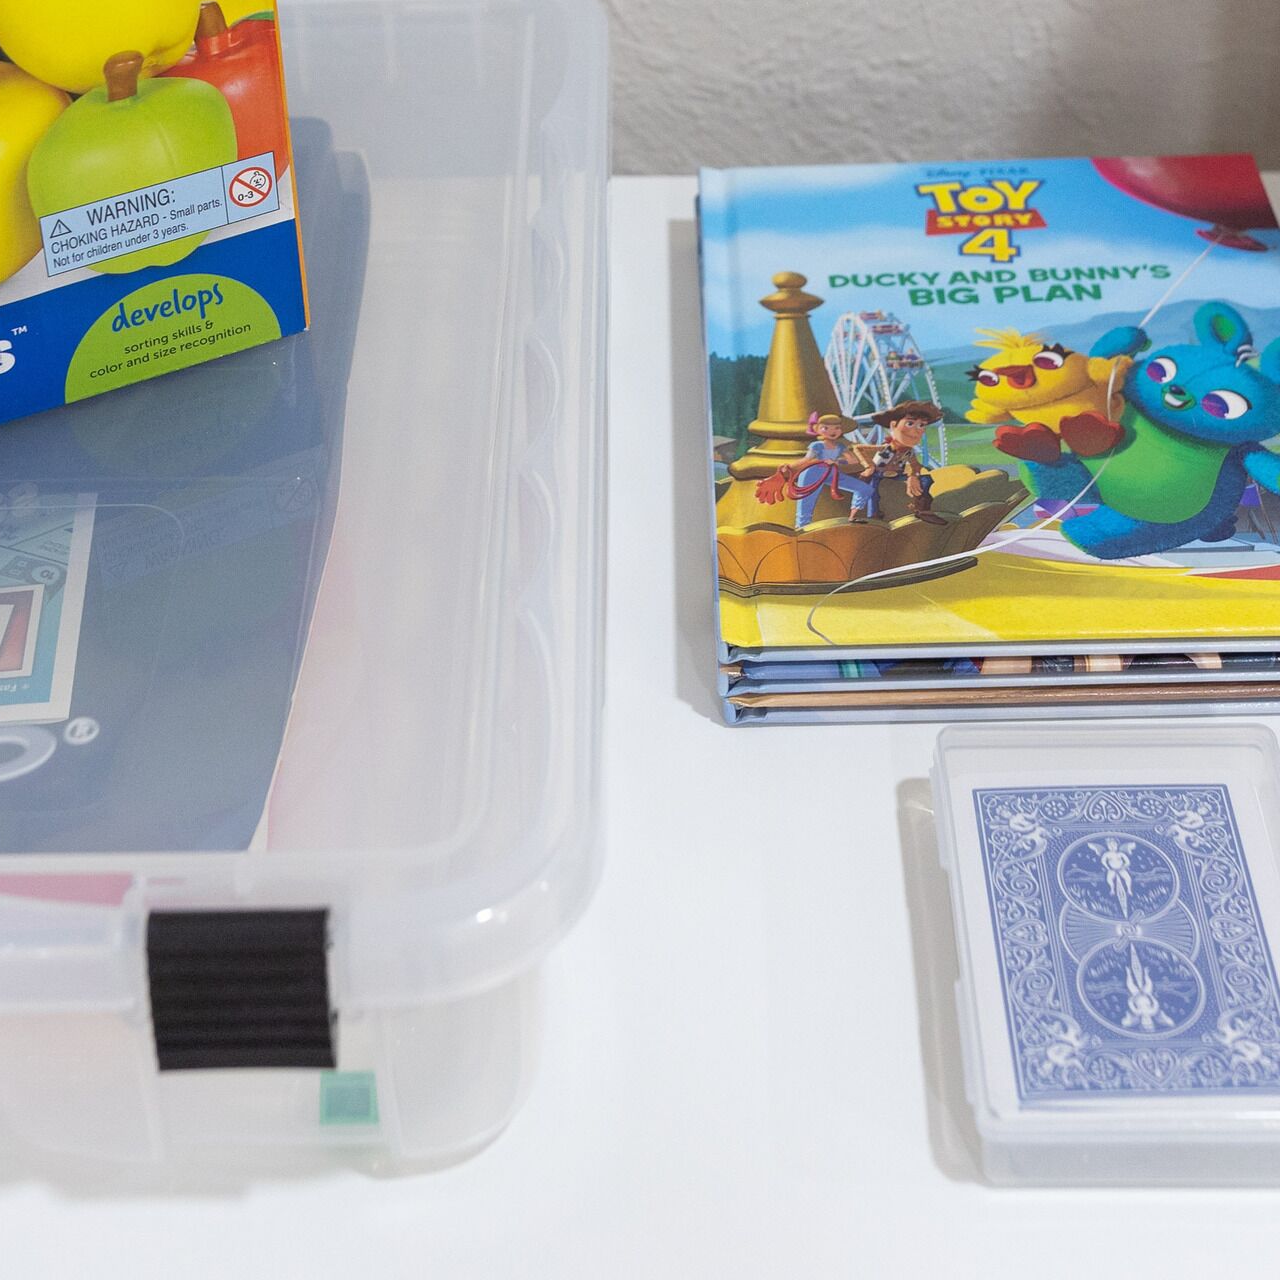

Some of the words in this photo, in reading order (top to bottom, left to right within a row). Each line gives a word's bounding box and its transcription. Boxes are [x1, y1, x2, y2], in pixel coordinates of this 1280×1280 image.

[86, 188, 176, 226] WARNING:
[917, 179, 1043, 213] TOY
[50, 228, 108, 253] CHOKING
[110, 213, 160, 238] HAZARD
[169, 204, 196, 221] Small
[197, 198, 223, 215] parts.
[936, 213, 1032, 228] STORY
[53, 256, 71, 268] Not
[71, 252, 85, 263] for
[86, 240, 124, 259] children
[124, 232, 152, 248] under
[152, 229, 160, 239] 3
[160, 222, 189, 238] years.
[960, 227, 1019, 263] 4
[828, 271, 941, 288] DUCKY
[948, 269, 1016, 285] AND
[908, 287, 980, 306] BIG
[995, 284, 1103, 304] PLAN
[111, 282, 224, 333] develops
[90, 362, 123, 379] color
[126, 353, 150, 368] and
[152, 347, 177, 361] size
[180, 323, 251, 353] recognition
[124, 335, 170, 355] sorting
[172, 323, 202, 340] skills
[205, 320, 214, 330] &
